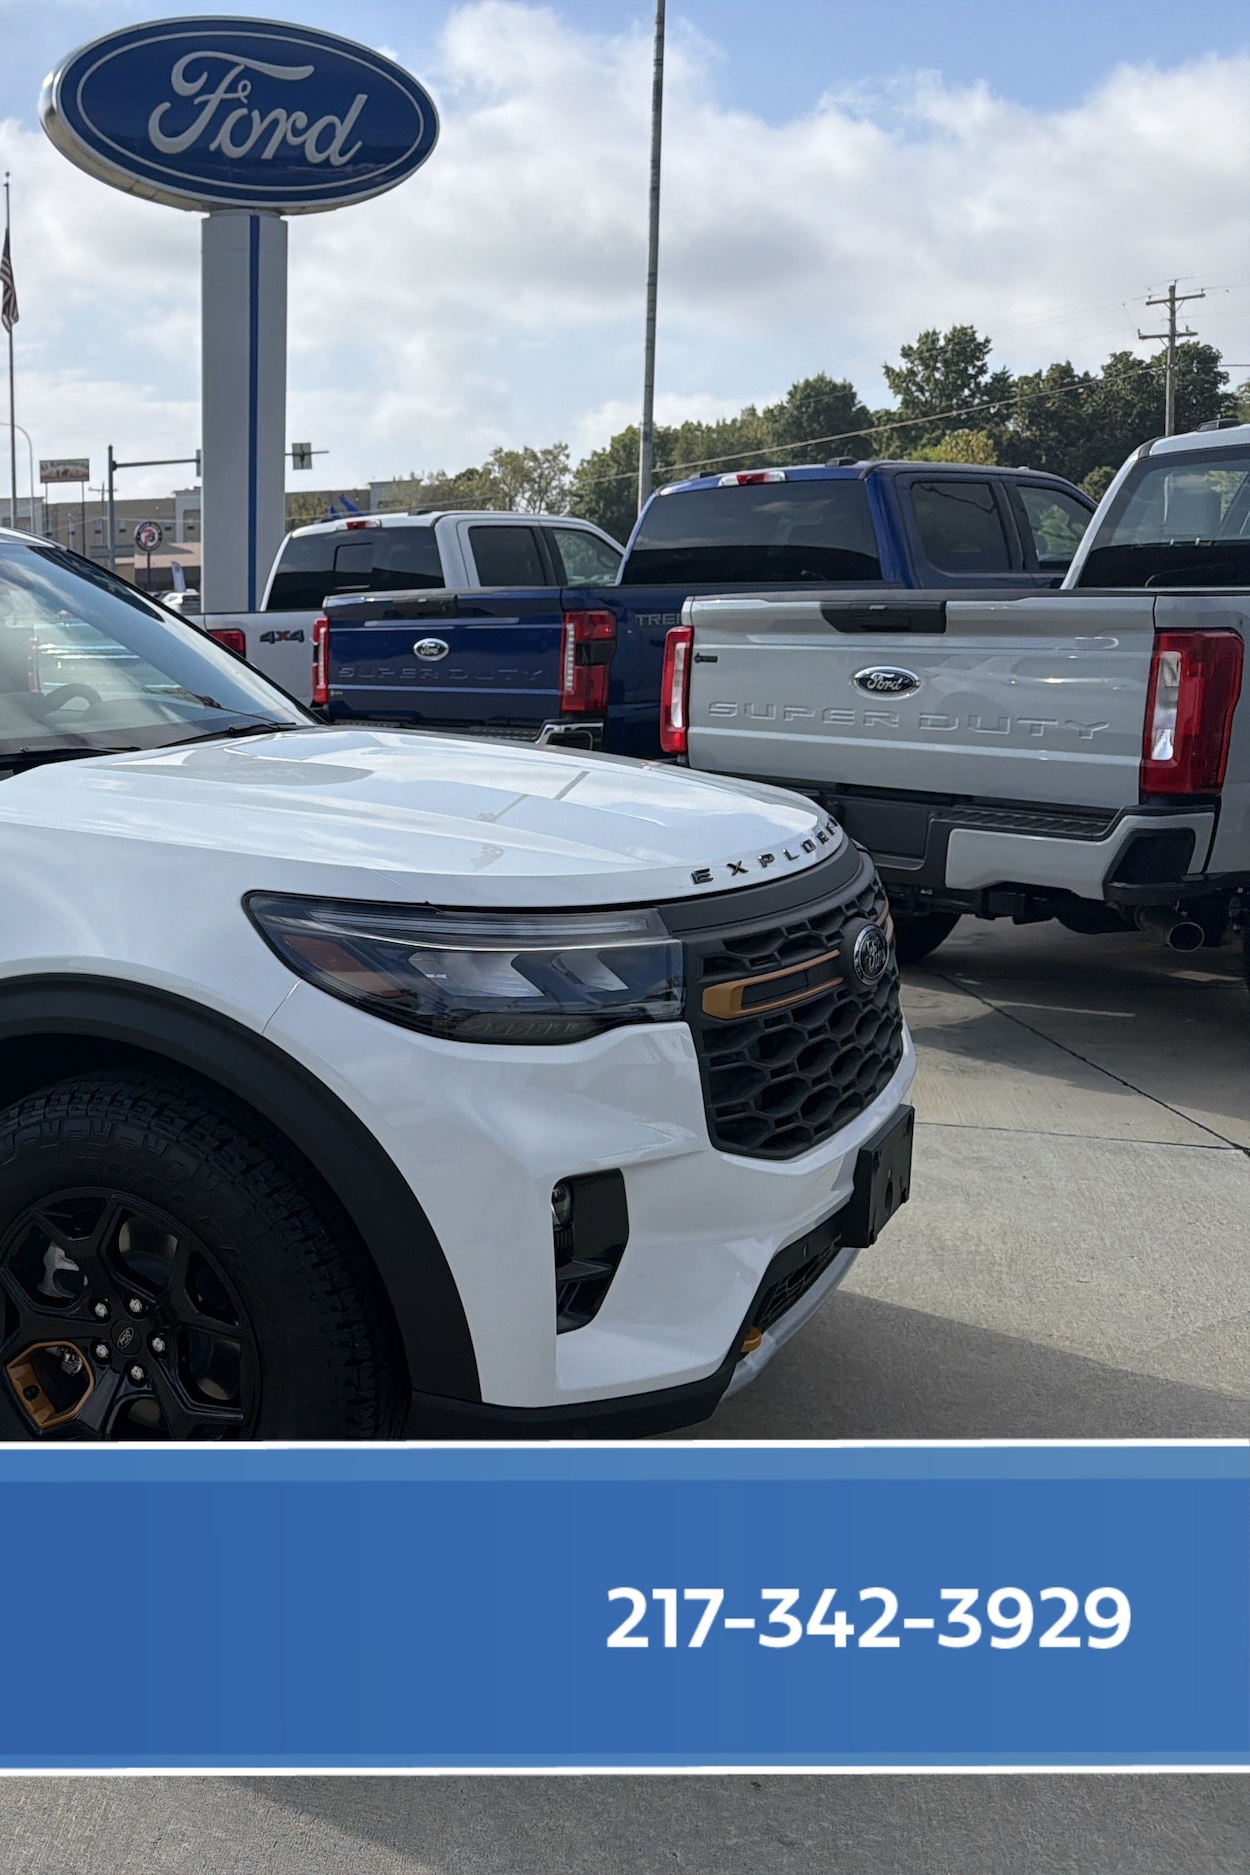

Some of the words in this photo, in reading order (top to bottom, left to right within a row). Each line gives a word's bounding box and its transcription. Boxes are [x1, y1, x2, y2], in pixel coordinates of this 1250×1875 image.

[148, 50, 368, 167] Ford
[635, 613, 681, 626] TRE
[338, 667, 439, 680] SUPER
[449, 668, 543, 681] DUTY
[867, 672, 903, 691] Ford
[708, 701, 900, 727] SUPER
[918, 712, 1109, 740] DUTY
